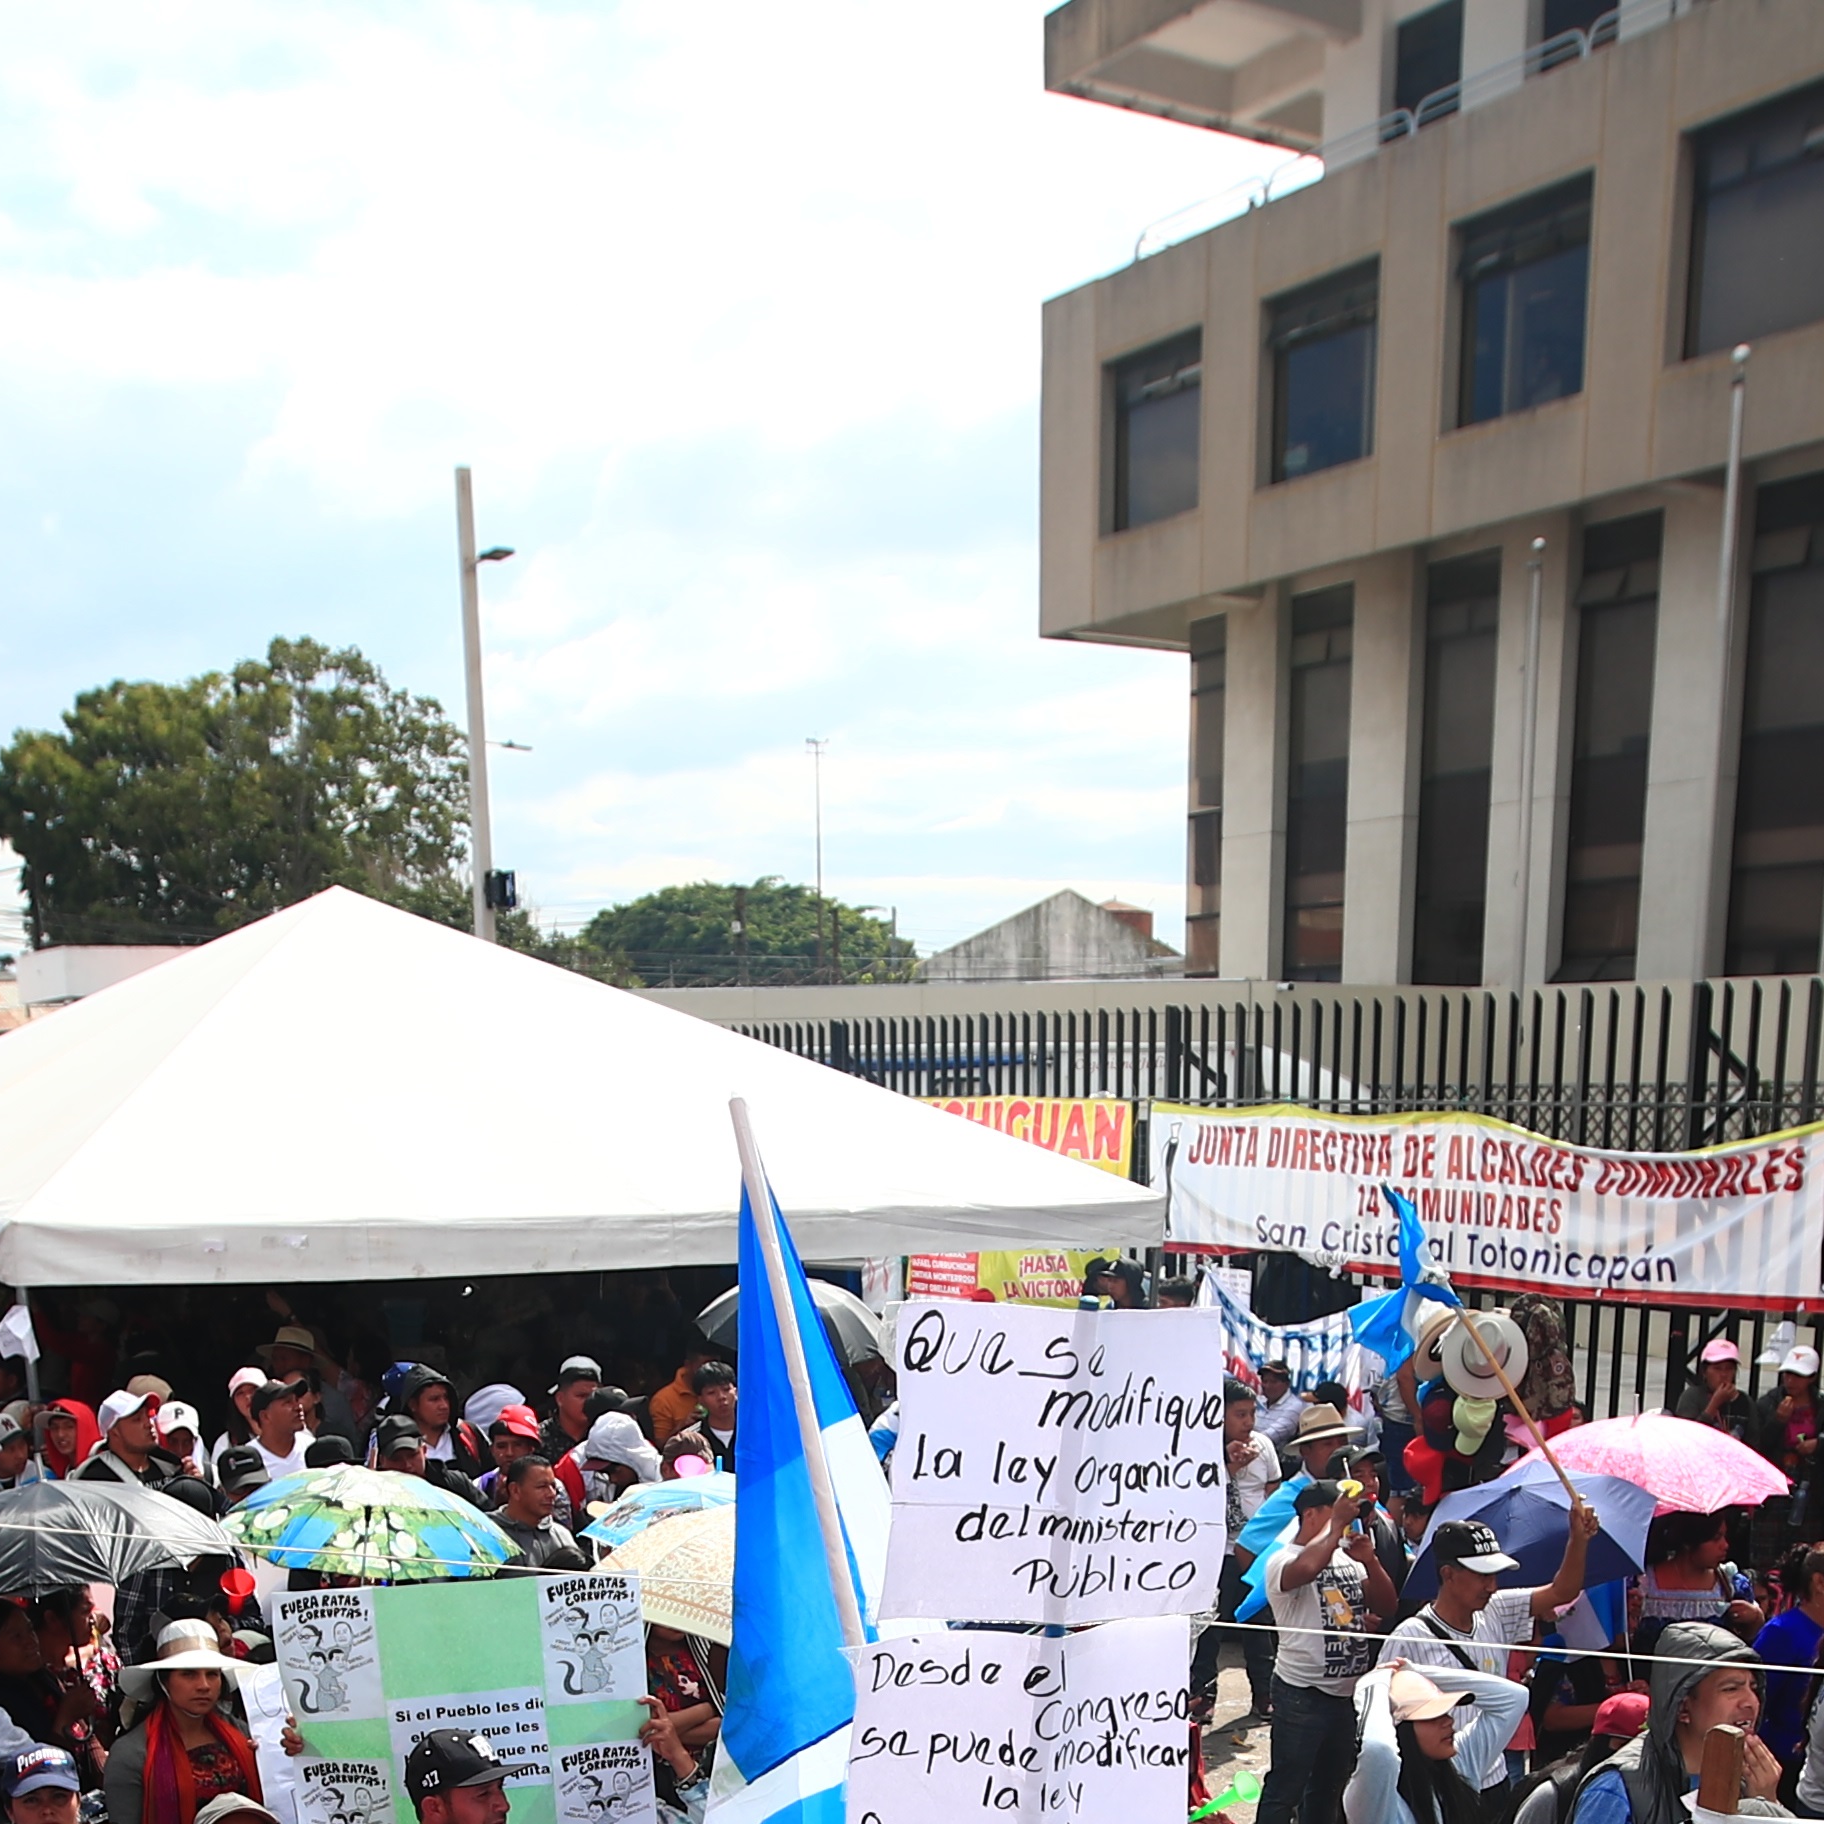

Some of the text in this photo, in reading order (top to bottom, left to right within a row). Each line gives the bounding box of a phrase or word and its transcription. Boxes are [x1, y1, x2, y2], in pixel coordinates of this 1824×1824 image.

[1188, 1123, 1807, 1199] JUNTA DIRECTIVA DE ALCALDES COMUNALES
[1358, 1184, 1380, 1218] 14
[1256, 1215, 1676, 1288] San Cristóal Totonicapán
[1003, 1281, 1020, 1298] LA
[547, 1577, 627, 1603] FUERA RATAS
[280, 1595, 360, 1620] FUERA RATAS
[395, 1702, 520, 1722] Si el Pueblo les
[482, 1722, 539, 1739] que les
[497, 1745, 526, 1759] que
[561, 1746, 639, 1772] FUERA RATAS
[303, 1762, 378, 1783] FUERA RATAS
